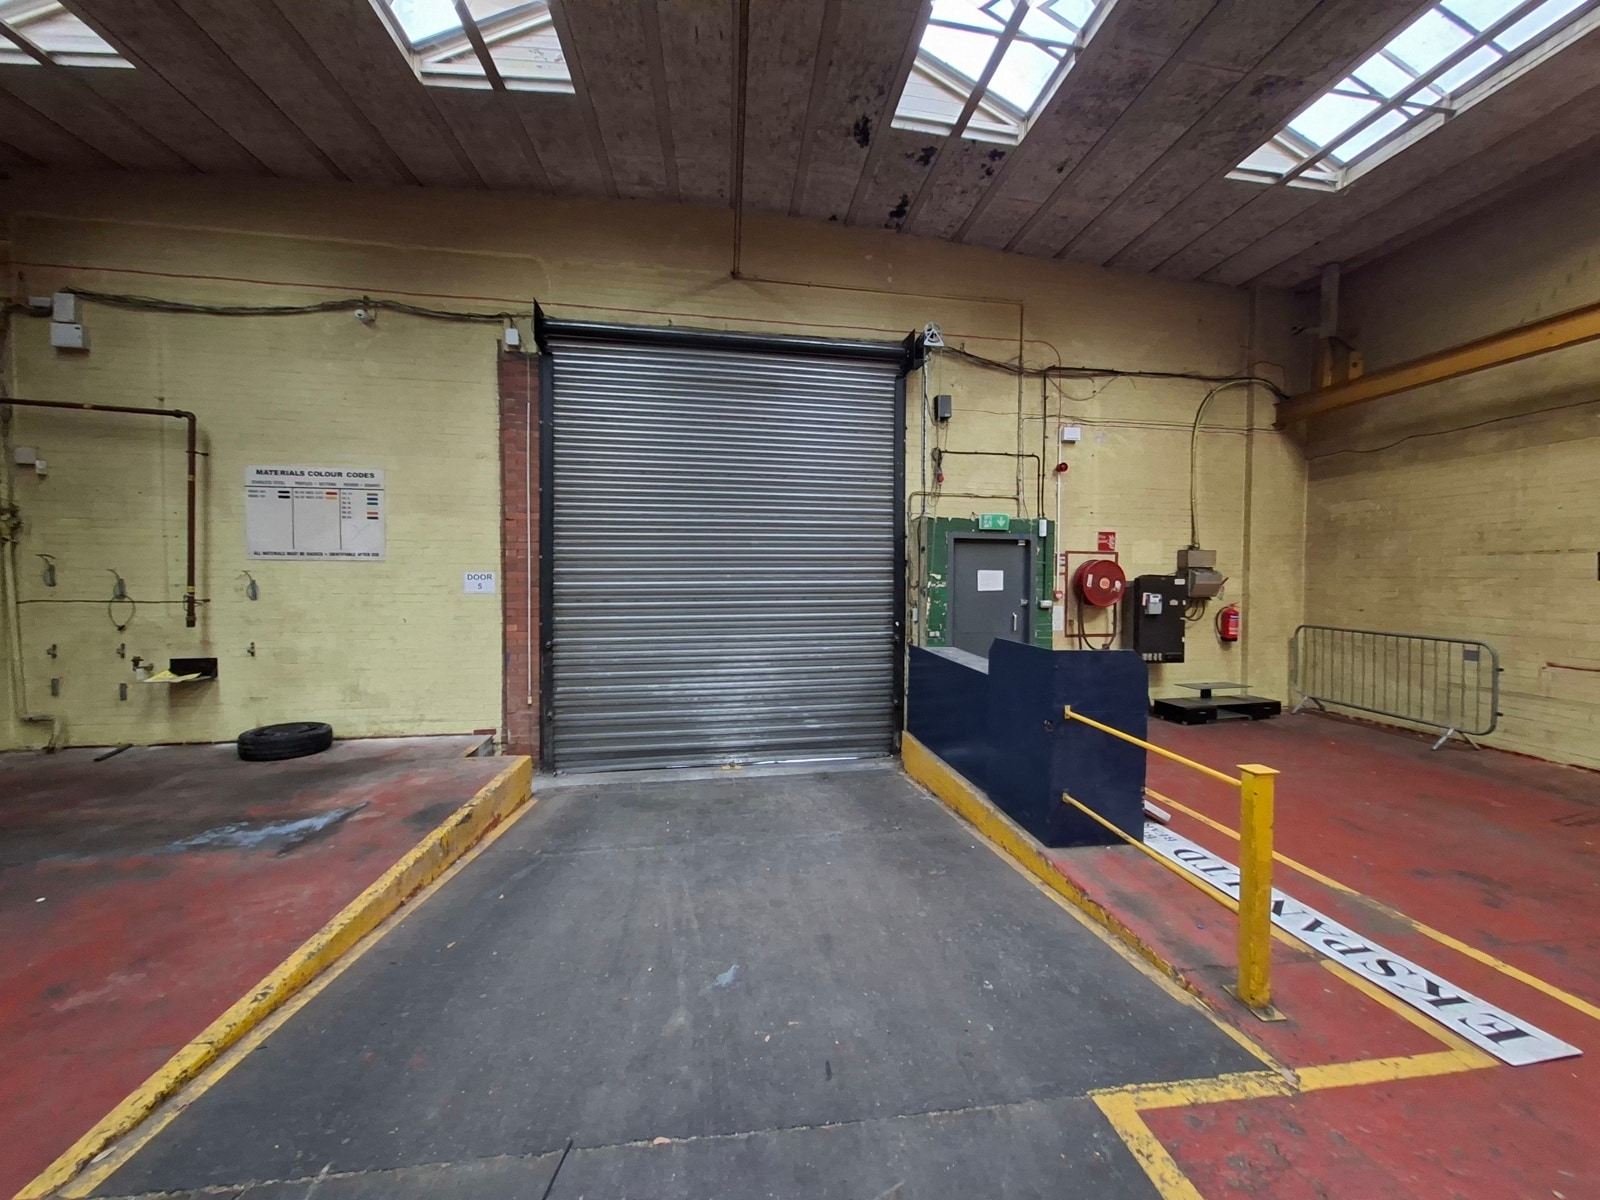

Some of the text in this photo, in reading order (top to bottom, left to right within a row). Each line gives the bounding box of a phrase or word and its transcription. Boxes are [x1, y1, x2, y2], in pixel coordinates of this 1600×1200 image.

[256, 469, 305, 477] MATERIALS
[308, 470, 343, 478] COLOUR
[467, 573, 493, 581] DOOR
[477, 582, 483, 590] 5
